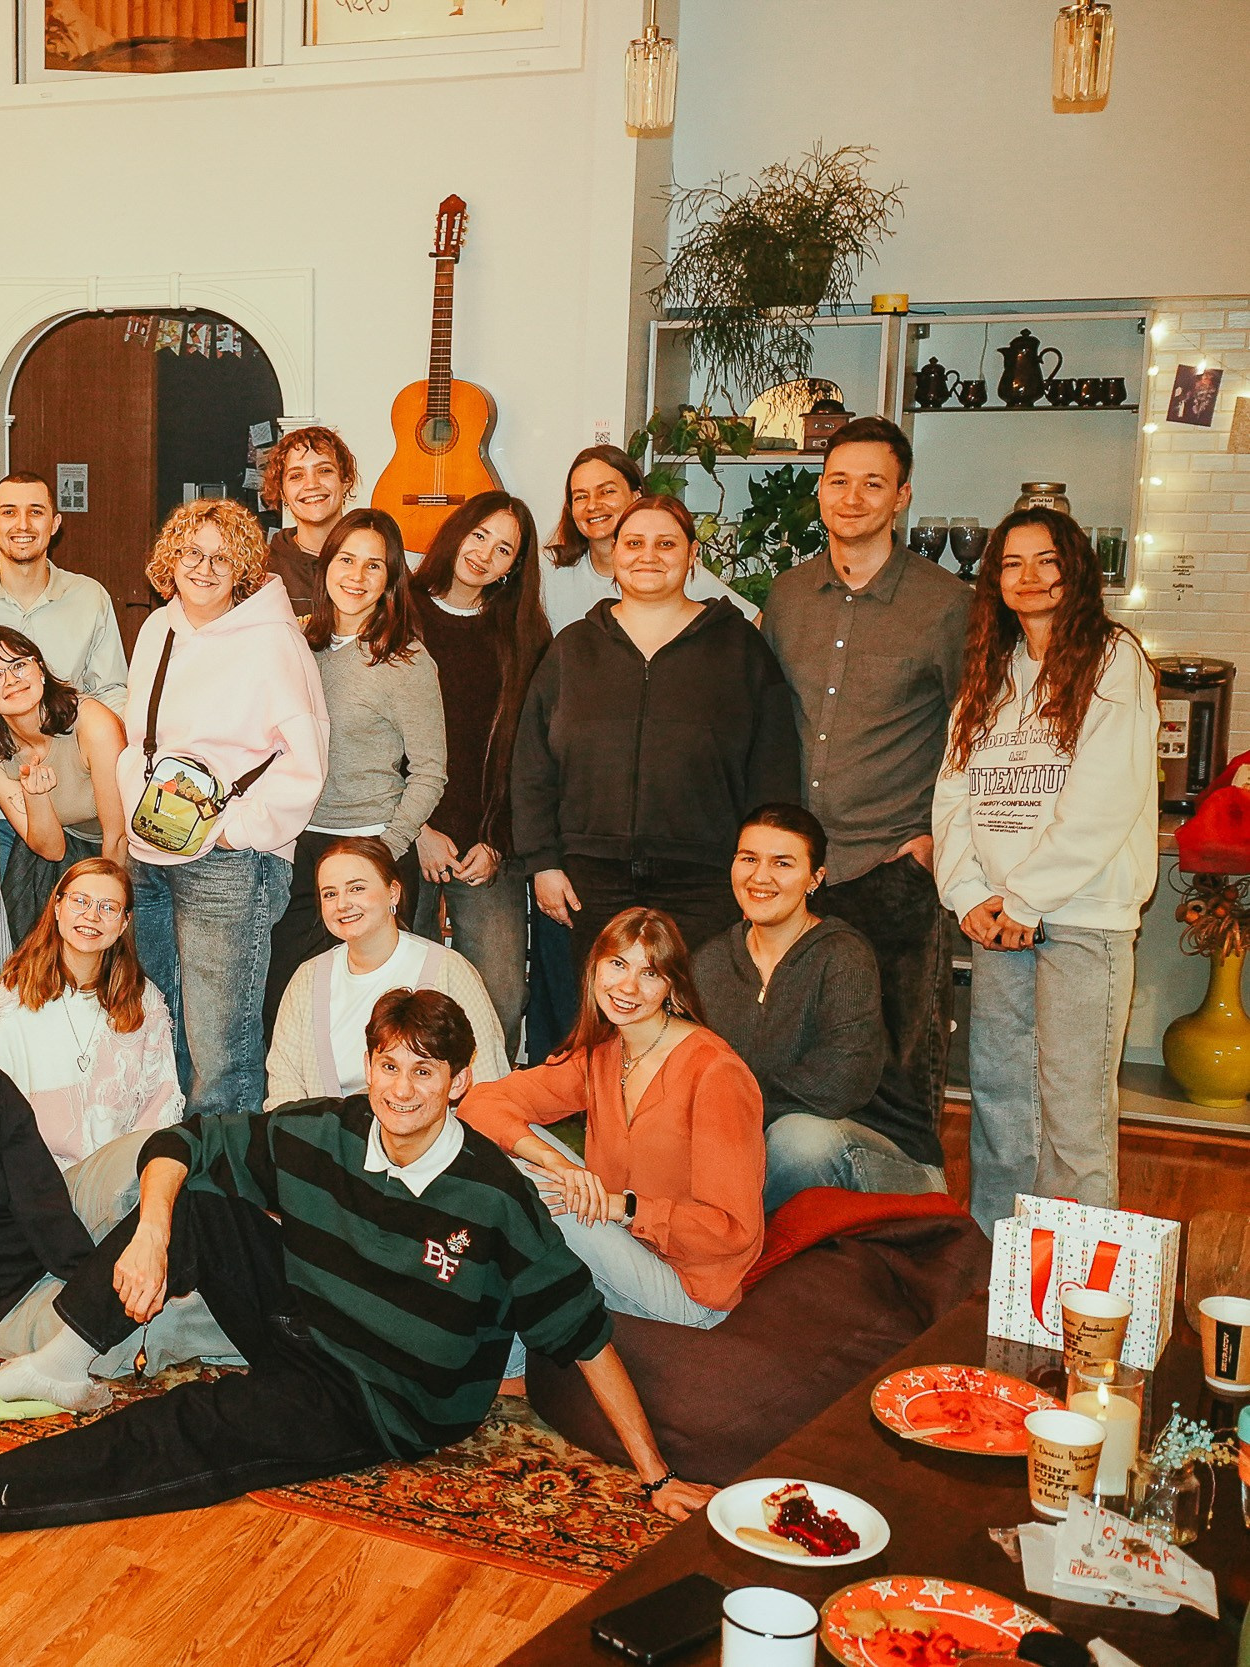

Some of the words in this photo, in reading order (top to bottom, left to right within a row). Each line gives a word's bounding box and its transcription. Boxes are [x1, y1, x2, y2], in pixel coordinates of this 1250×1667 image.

[424, 1239, 460, 1281] BF
[1033, 1459, 1070, 1476] DRINK
[1034, 1467, 1065, 1483] PURE
[1033, 1475, 1080, 1491] COFFEE
